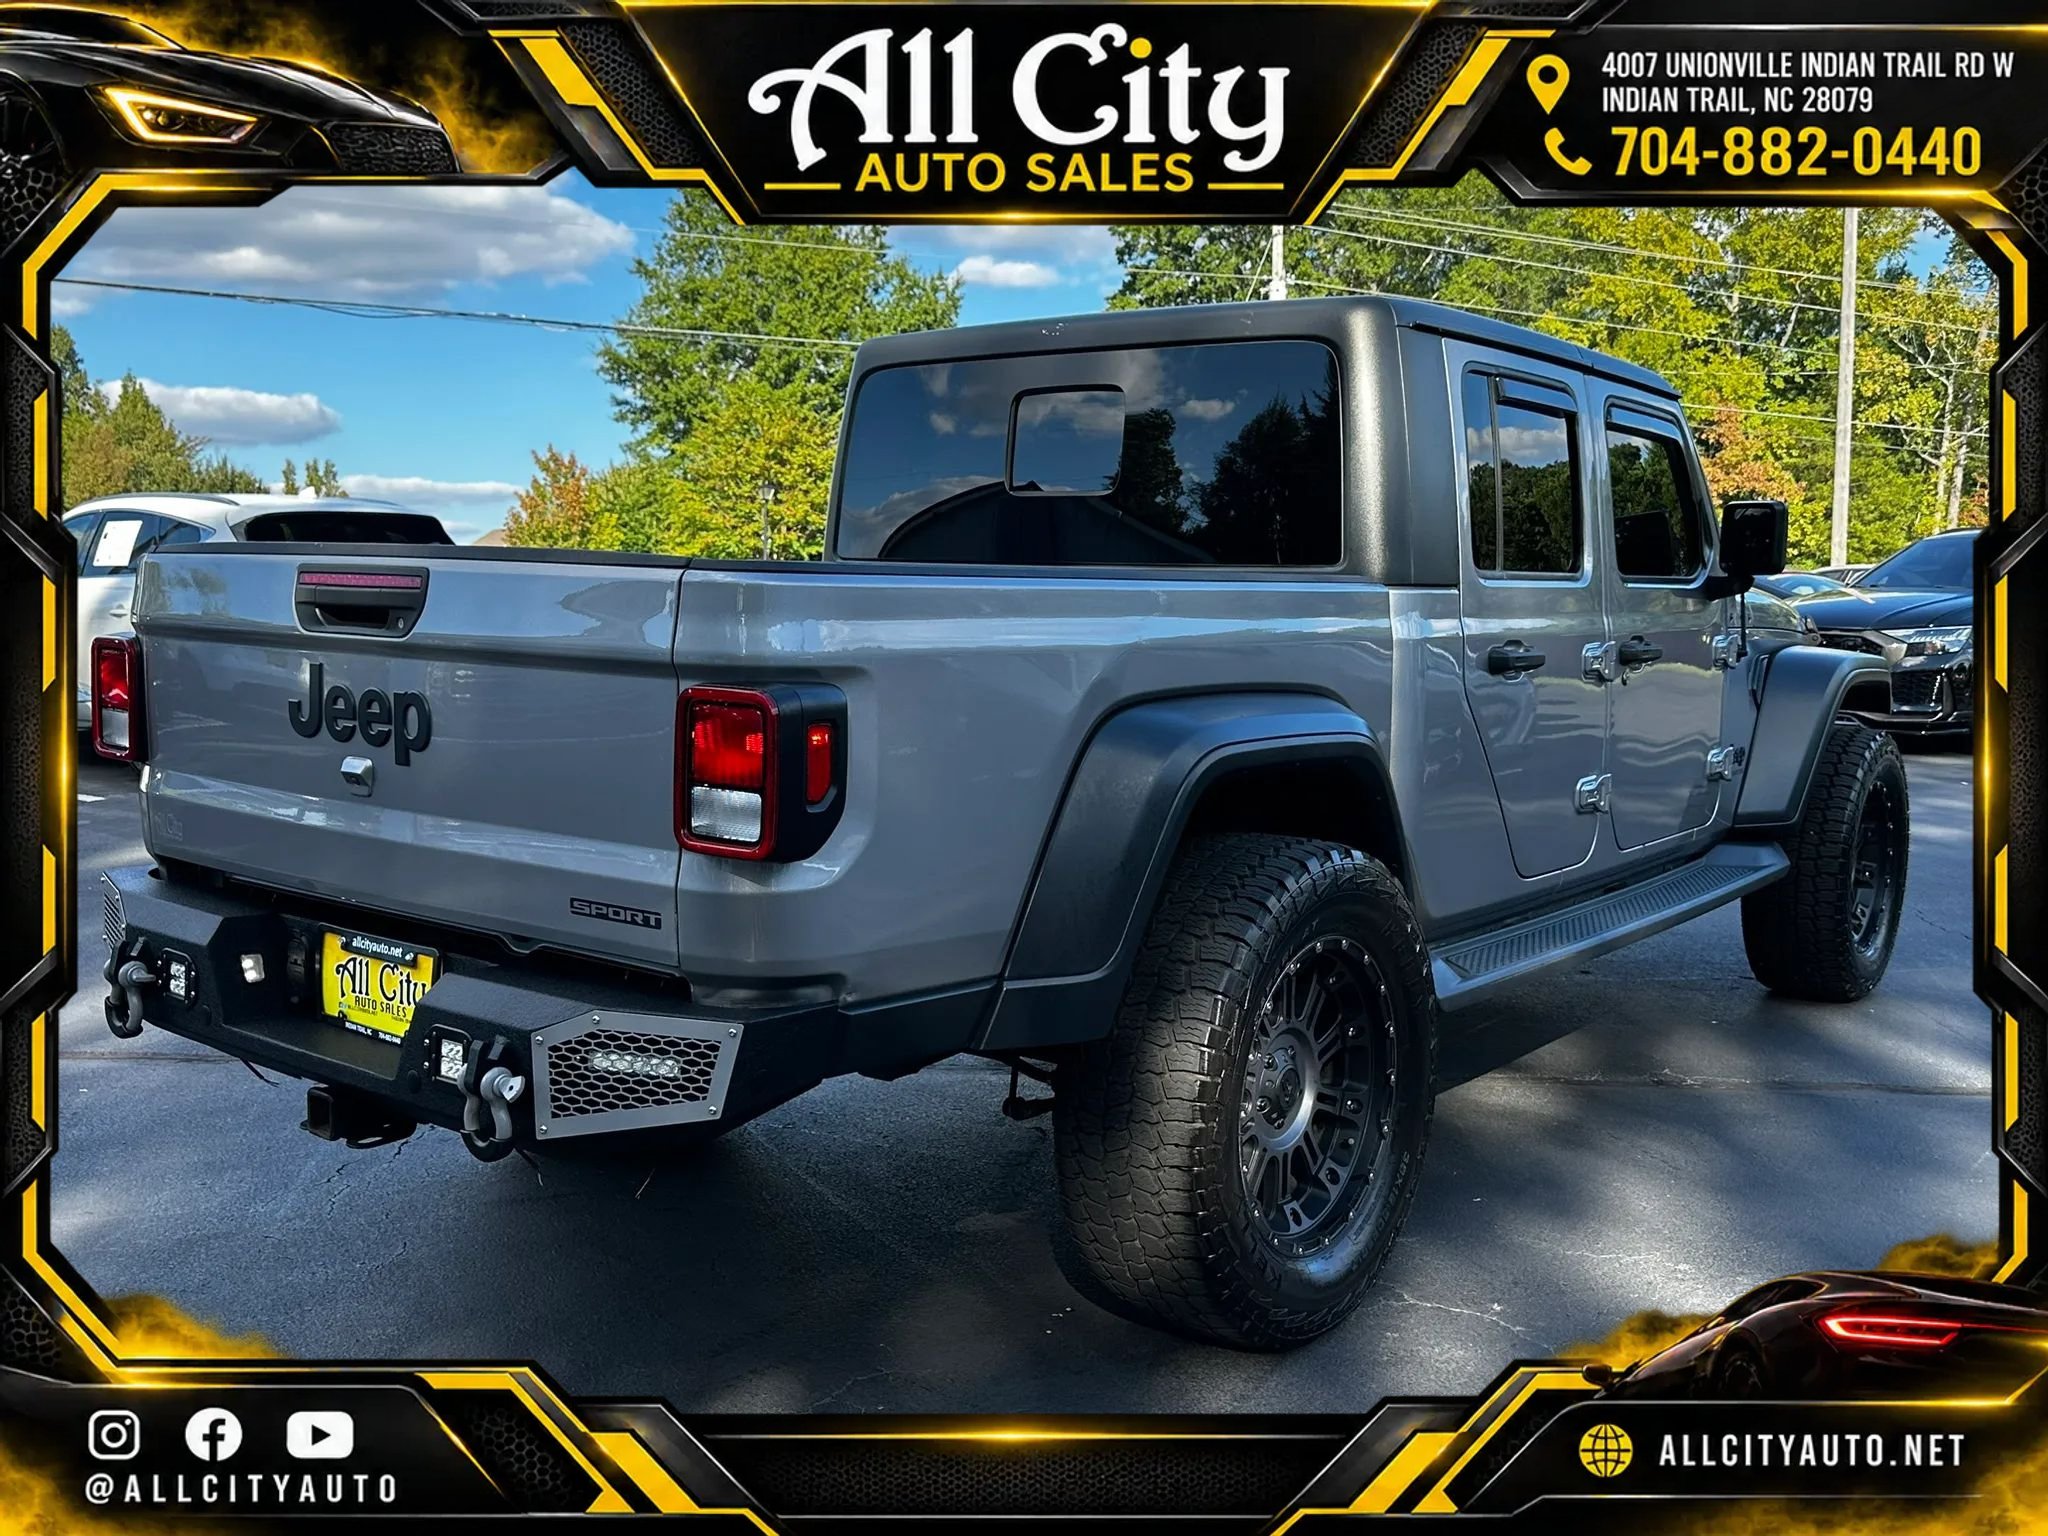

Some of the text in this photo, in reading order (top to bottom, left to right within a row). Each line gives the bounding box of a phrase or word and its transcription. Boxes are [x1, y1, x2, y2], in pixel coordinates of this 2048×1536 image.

[288, 661, 432, 767] Jeep
[570, 900, 662, 926] SPORT
[351, 935, 403, 958] allcityauto.net
[335, 956, 370, 999] All
[354, 995, 378, 1011] AUTO
[380, 1001, 407, 1018] SALES
